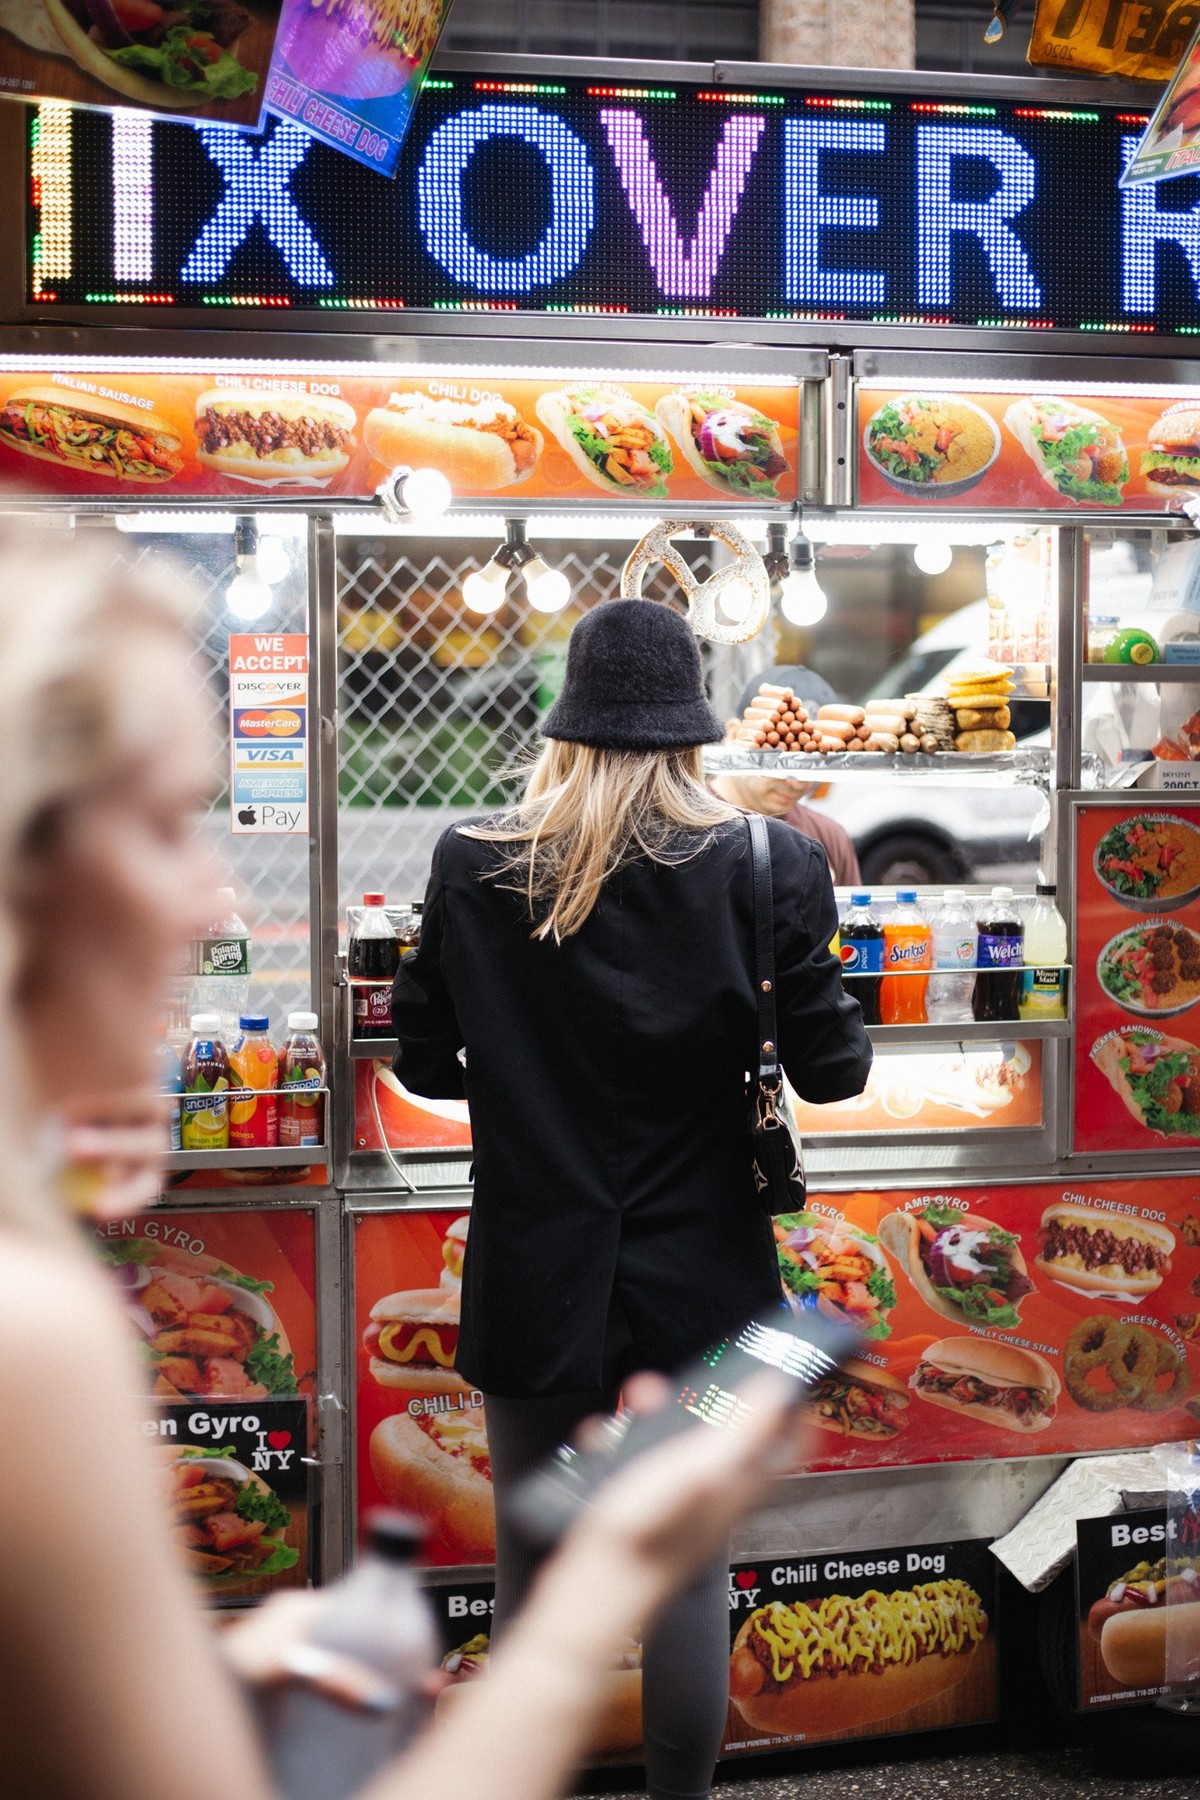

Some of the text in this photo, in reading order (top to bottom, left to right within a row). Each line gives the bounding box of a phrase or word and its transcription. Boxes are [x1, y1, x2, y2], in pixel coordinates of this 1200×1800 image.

[268, 75, 389, 162] CHILI CHEESE DOG
[418, 104, 1042, 310] OVER
[52, 373, 155, 411] ITALIAN SAUSAGE
[215, 375, 340, 396] CHILI CHEESE DOG
[428, 382, 503, 402] CHILI DOG
[254, 637, 284, 652] WE
[233, 656, 305, 671] ACCEPT
[238, 682, 301, 691] DISCOVER
[240, 719, 300, 728] MasterCard
[247, 749, 295, 761] VISA
[252, 788, 304, 798] EXPRESS
[1163, 781, 1199, 789] 200CT
[261, 806, 301, 831] Pay
[211, 941, 240, 957] Poland
[212, 951, 242, 966] Spring
[890, 942, 928, 962] Sunkist
[1088, 1025, 1166, 1059] FALAFEL SANDWICH
[197, 1061, 225, 1069] NATURAL
[810, 1202, 846, 1224] GYRO
[896, 1195, 970, 1216] LAMB GYRO
[1062, 1191, 1167, 1222] CHILI CHEESE DOG
[144, 1221, 205, 1256] GYRO
[968, 1325, 1060, 1356] PHILLY CHEESE STEAK
[1120, 1314, 1188, 1362] CHEESE PRETZEL
[407, 1392, 465, 1417] CHILI
[188, 1411, 261, 1440] Gyro
[256, 1431, 268, 1451] I
[251, 1450, 295, 1471] NY
[1111, 1518, 1178, 1548] Best
[771, 1553, 946, 1586] Chili Cheese Dog
[1089, 1694, 1111, 1704] ASTORIA
[1112, 1690, 1137, 1701] PRINTING
